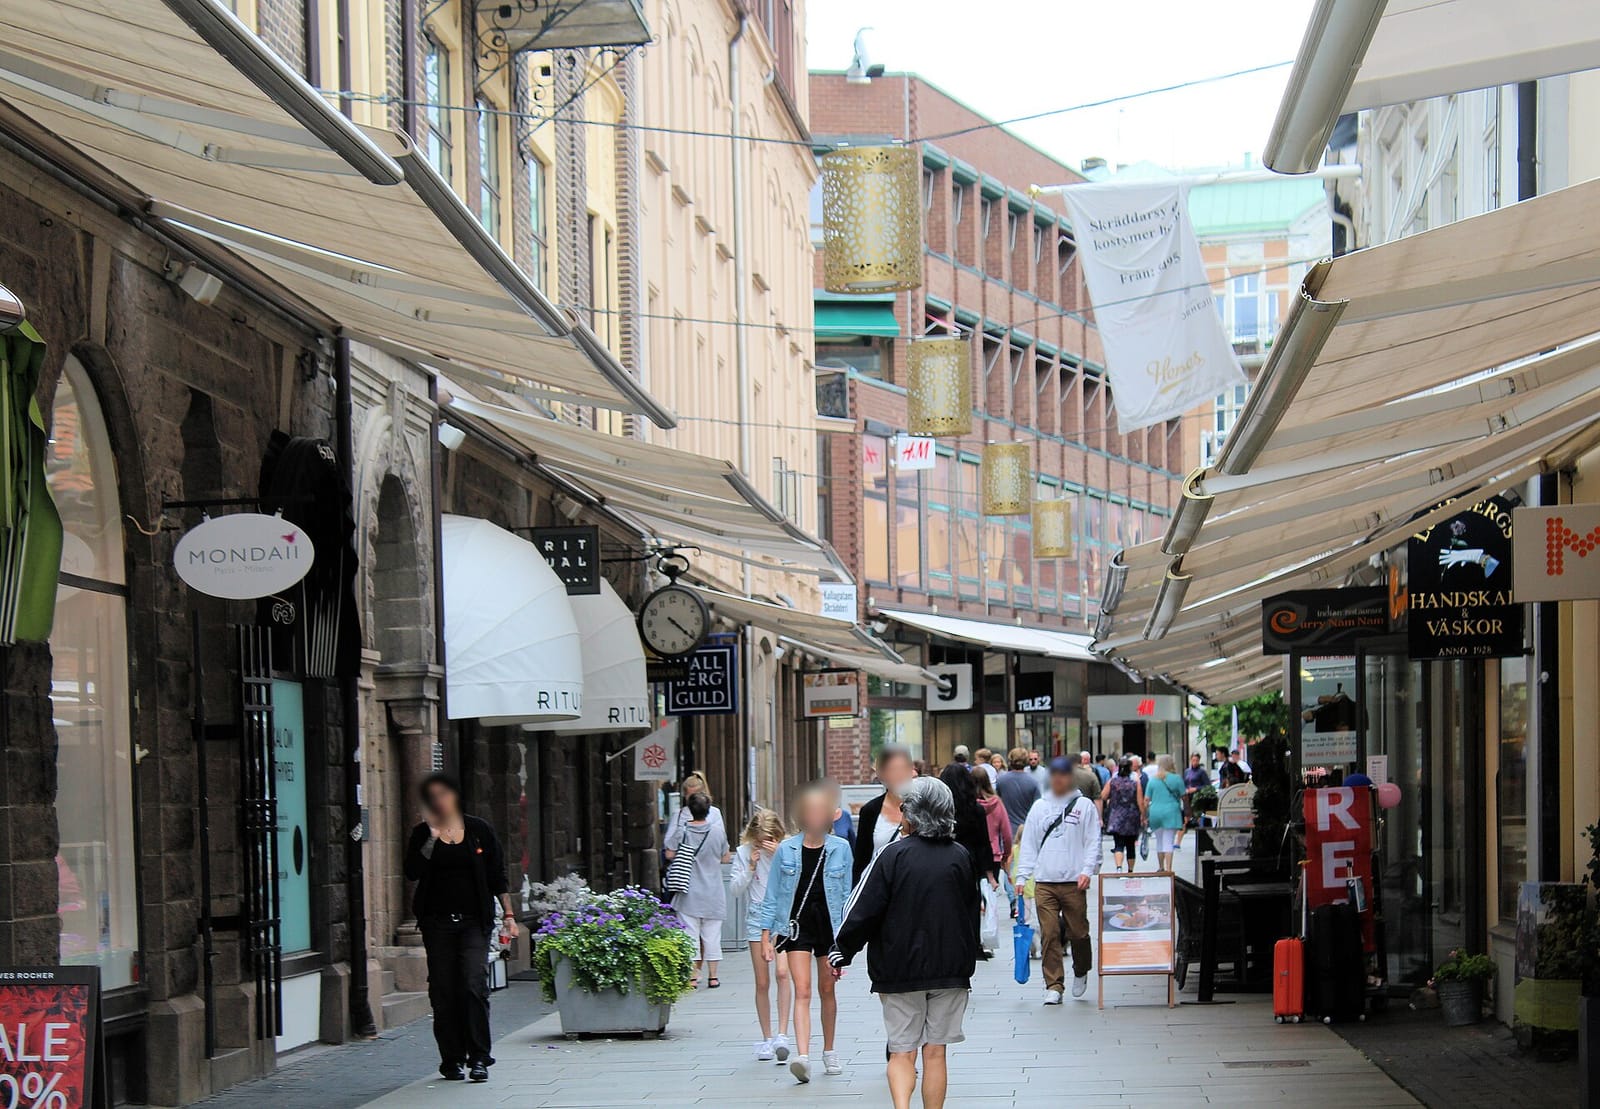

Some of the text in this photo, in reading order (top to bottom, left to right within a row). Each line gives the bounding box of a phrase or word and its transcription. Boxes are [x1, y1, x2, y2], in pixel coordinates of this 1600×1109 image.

[1461, 609, 1469, 619] &
[1426, 618, 1504, 637] VÄSKOR
[1438, 646, 1468, 656] ANNO
[537, 690, 583, 711] RITU
[675, 690, 725, 706] GULD
[1017, 695, 1052, 711] TELE2
